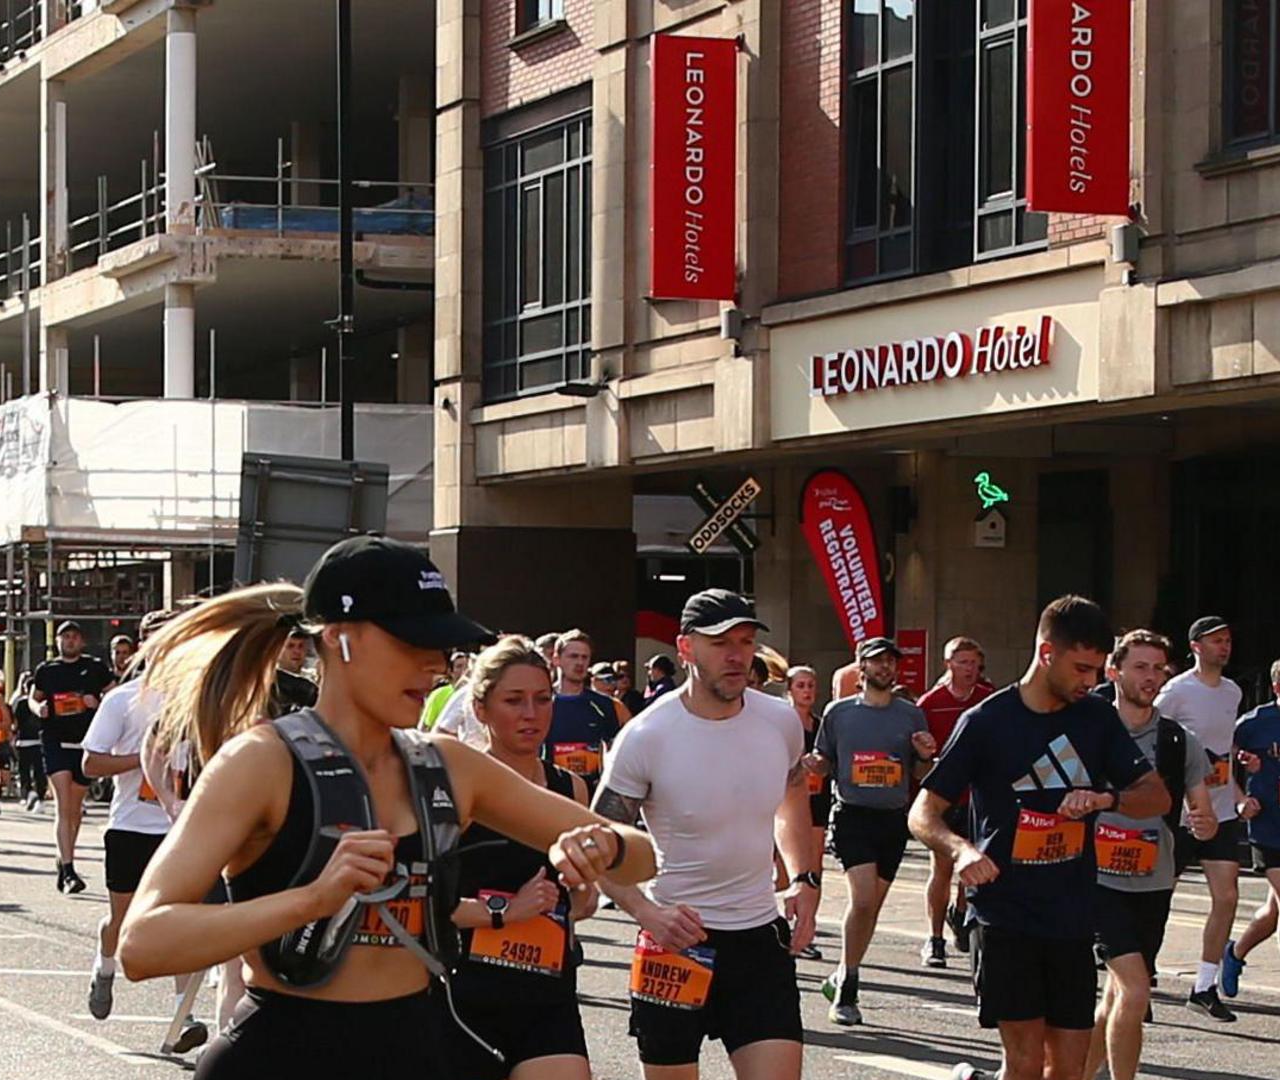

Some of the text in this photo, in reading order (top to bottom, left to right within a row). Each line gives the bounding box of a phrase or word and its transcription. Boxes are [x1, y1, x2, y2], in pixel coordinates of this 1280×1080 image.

[1070, 3, 1092, 193] ARDO Hotels
[684, 53, 705, 283] LEONARDO Hotels
[809, 315, 1053, 398] LEONARDO Hotel
[694, 484, 756, 549] ODDSOCKS
[820, 518, 866, 642] REGISTRATION
[839, 524, 877, 623] VOLUNTEER
[641, 978, 682, 1000] 21277
